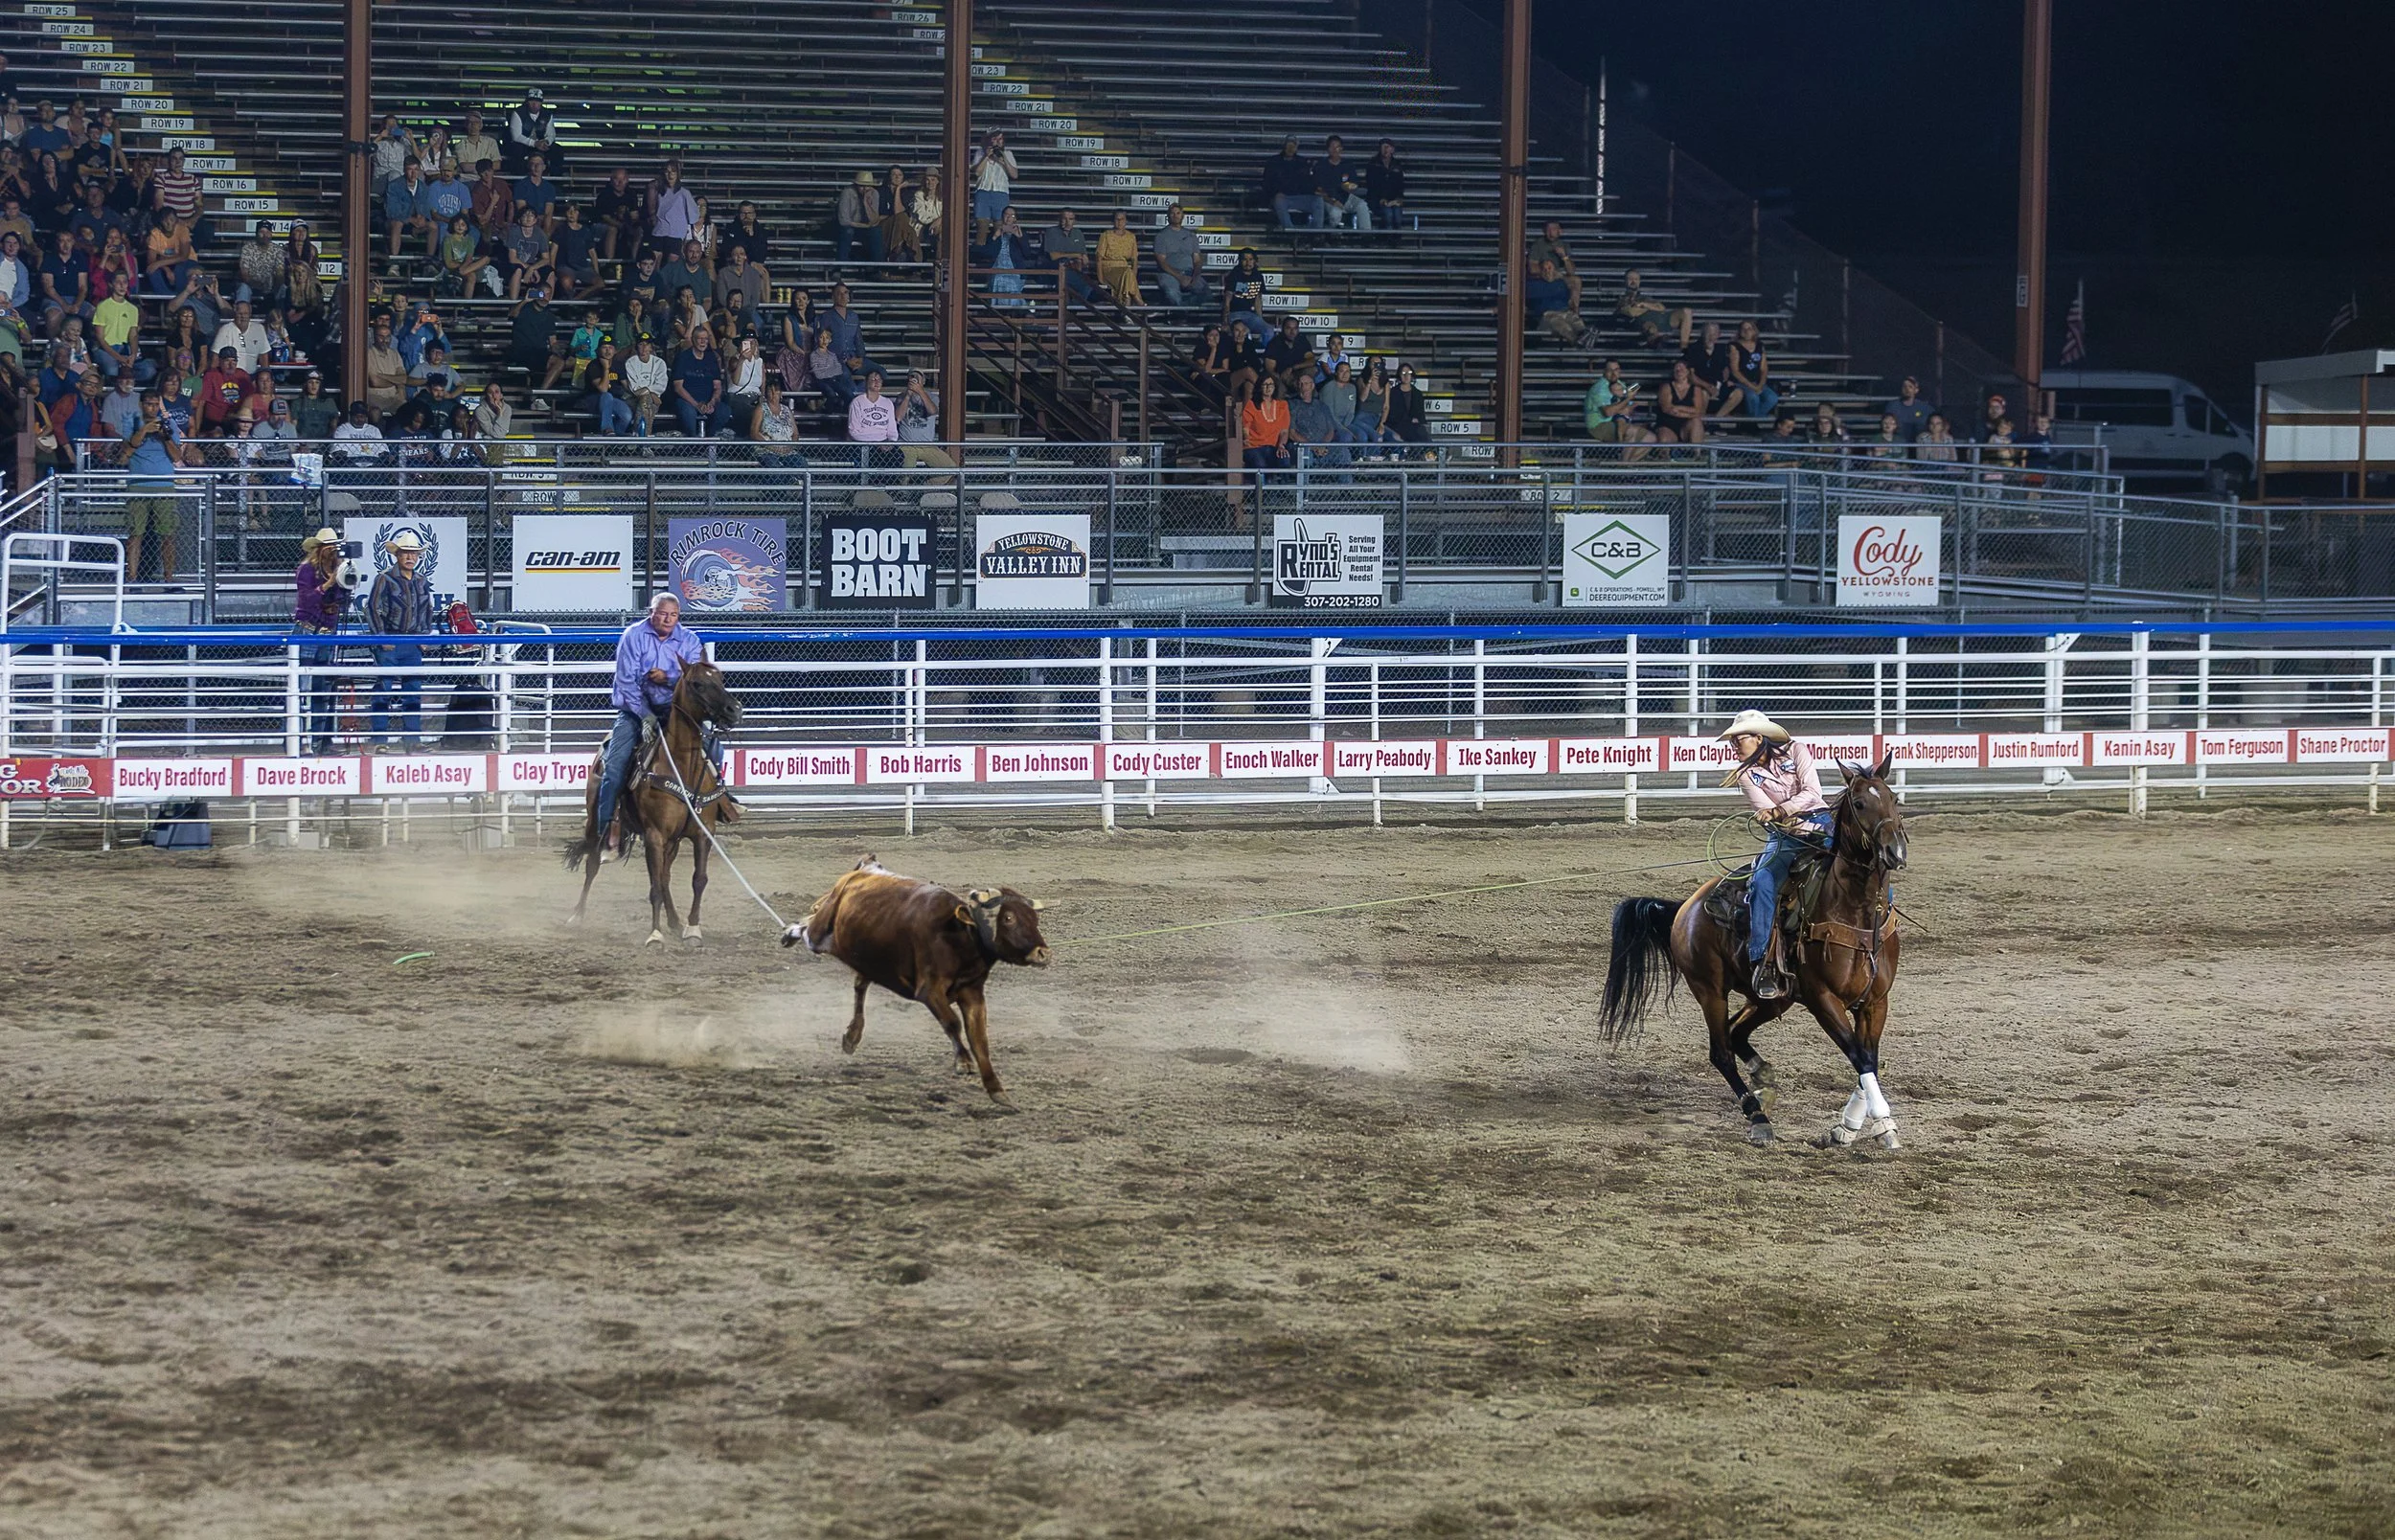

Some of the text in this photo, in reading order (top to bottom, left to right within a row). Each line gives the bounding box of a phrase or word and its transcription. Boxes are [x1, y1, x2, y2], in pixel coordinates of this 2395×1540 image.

[56, 7, 68, 15] 25
[50, 25, 70, 33] ROW
[69, 43, 105, 52] ROW 23
[91, 62, 127, 71] ROW 22
[110, 81, 143, 90] ROW 21
[990, 84, 1008, 93] ROW
[131, 100, 167, 109] ROW 20
[1015, 102, 1033, 111] ROW
[151, 119, 184, 128] ROW 19
[1039, 121, 1071, 129] ROW 20
[172, 140, 205, 149] ROW 18
[1066, 139, 1095, 147] ROW 19
[193, 160, 226, 169] ROW 17
[1090, 158, 1120, 167] ROW 18
[213, 180, 247, 189] ROW 16
[1113, 177, 1143, 185] ROW 17
[234, 200, 269, 209] ROW 15
[1140, 197, 1170, 206] ROW 16
[1186, 216, 1195, 225] 15
[1197, 236, 1222, 245] OW 14
[1216, 256, 1235, 264] ROW
[326, 265, 335, 273] 12
[1265, 276, 1274, 284] 12
[1269, 297, 1288, 305] ROW
[1299, 317, 1329, 326] ROW 10
[1348, 337, 1353, 346] 9
[1435, 401, 1440, 410] 6
[1441, 424, 1469, 433] ROW 5
[1471, 446, 1492, 455] ROW
[533, 492, 556, 502] ROW
[670, 520, 785, 567] RIMROCK TIRE
[998, 533, 1069, 551] YELLOWSTONE
[1349, 536, 1376, 544] Serving
[831, 528, 927, 562] BOOT
[1591, 542, 1641, 558] C&B
[1853, 526, 1923, 577] Cody
[526, 551, 620, 566] can-am
[986, 556, 1081, 574] VALLEY INN
[831, 565, 926, 597] BARN
[1841, 577, 1934, 586] YELLOWSTONE
[1304, 596, 1379, 607] 307-202-1280
[1993, 741, 2078, 758] Justin Rumford
[2105, 739, 2175, 759] Kanin Asay
[2201, 738, 2283, 758] Tom Ferguson
[2300, 736, 2386, 754] Shane Proctor
[1567, 746, 1652, 766] Pete Knight
[1674, 745, 1739, 765] Ken Clayba
[1807, 743, 1868, 760] Mortensen
[1885, 742, 1977, 763] Frank Shepperson
[1226, 750, 1319, 769] Enoch Walker
[1339, 749, 1431, 771] Larry Peabody
[1459, 748, 1536, 768] Ike Sankey
[751, 756, 850, 779] Cody Bill Smith
[881, 755, 961, 773] Bob Harris
[992, 754, 1088, 772] Ben Johnson
[1113, 753, 1201, 775] Cody Custer
[258, 766, 346, 785] Dave Brock
[386, 765, 472, 786] Kaleb Asay
[513, 761, 590, 784] Clay Trya
[120, 766, 226, 790] Bucky Bradford
